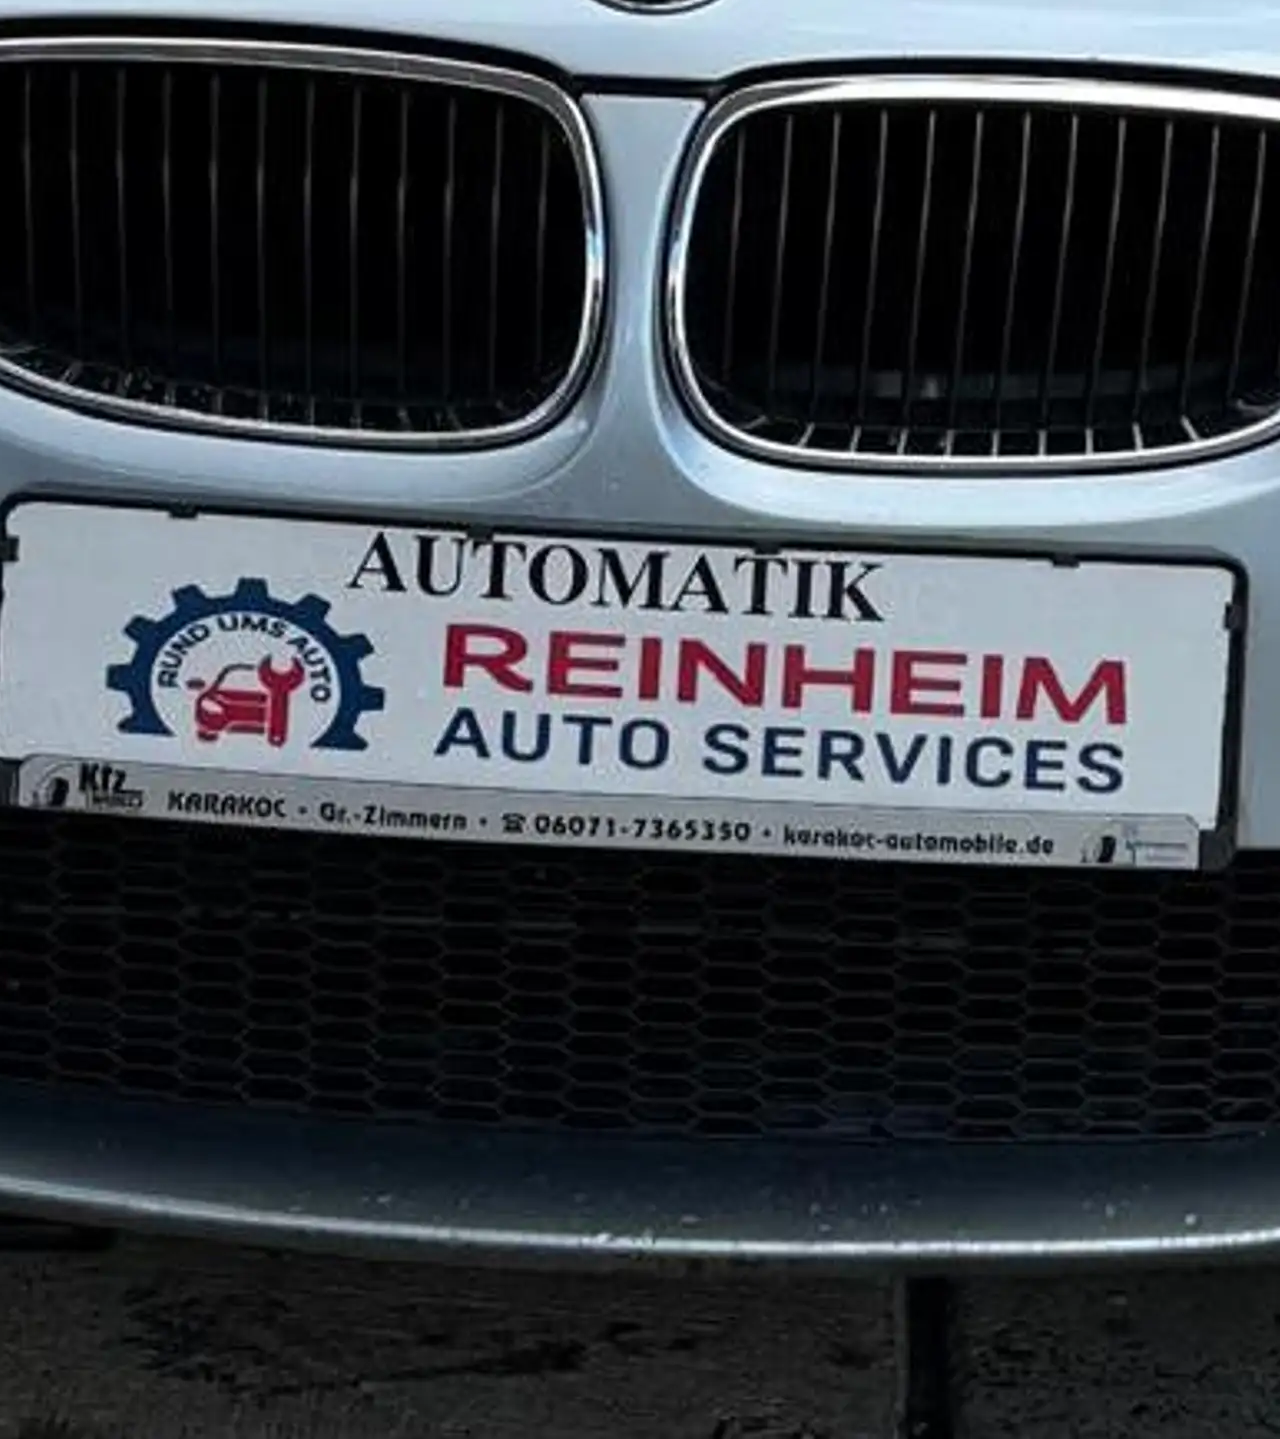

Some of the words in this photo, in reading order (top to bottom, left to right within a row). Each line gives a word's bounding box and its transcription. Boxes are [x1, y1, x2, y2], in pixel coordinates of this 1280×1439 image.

[348, 530, 887, 623] AUTOMATIK
[157, 622, 212, 689] RUND
[217, 613, 289, 638] UMS
[287, 635, 333, 704] AUTO
[443, 623, 1128, 726] REINHEIM
[434, 707, 670, 770] AUTO
[702, 722, 1126, 795] SERVICES
[167, 789, 288, 819] KARAKOC
[782, 823, 1055, 856] karakoc-automobile.de
